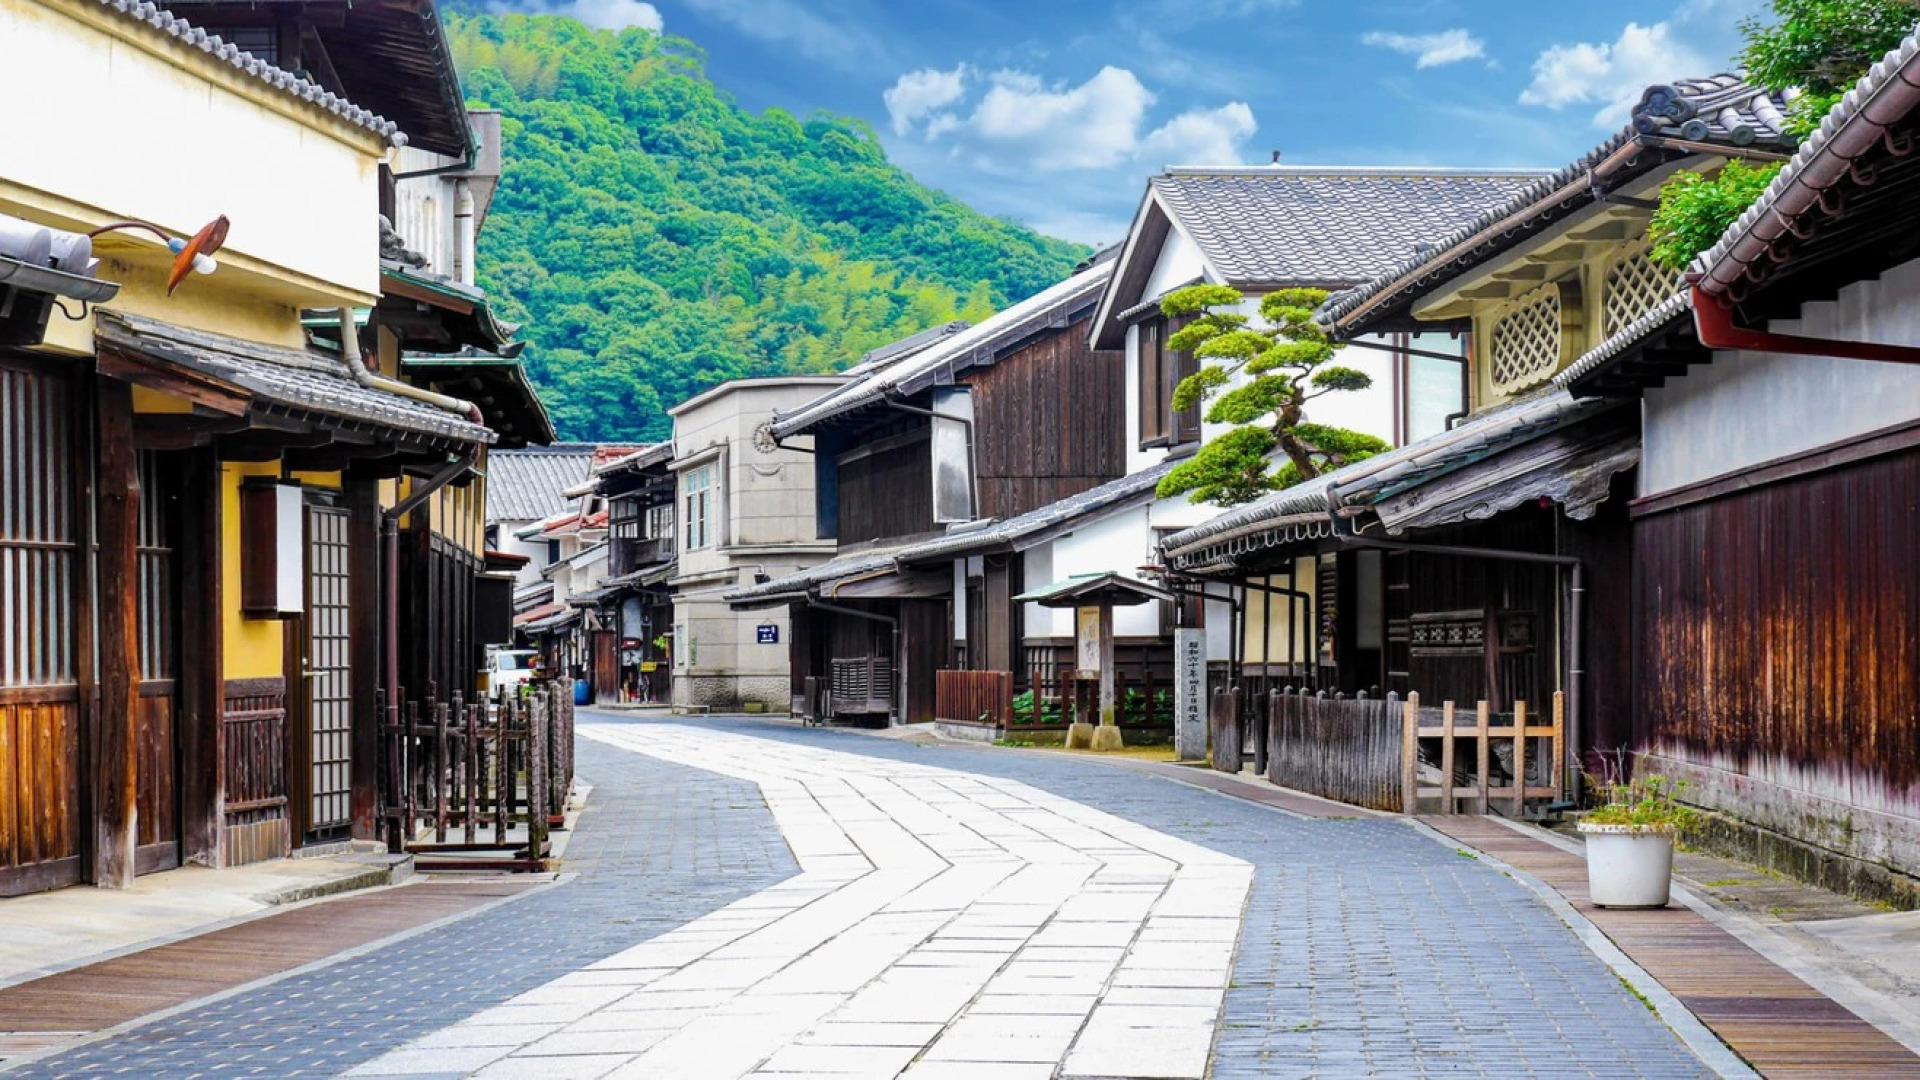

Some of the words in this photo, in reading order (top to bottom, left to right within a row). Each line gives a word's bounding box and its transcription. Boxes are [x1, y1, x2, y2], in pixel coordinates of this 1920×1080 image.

[1187, 641, 1200, 723] 昭和六十年四月十日指定
